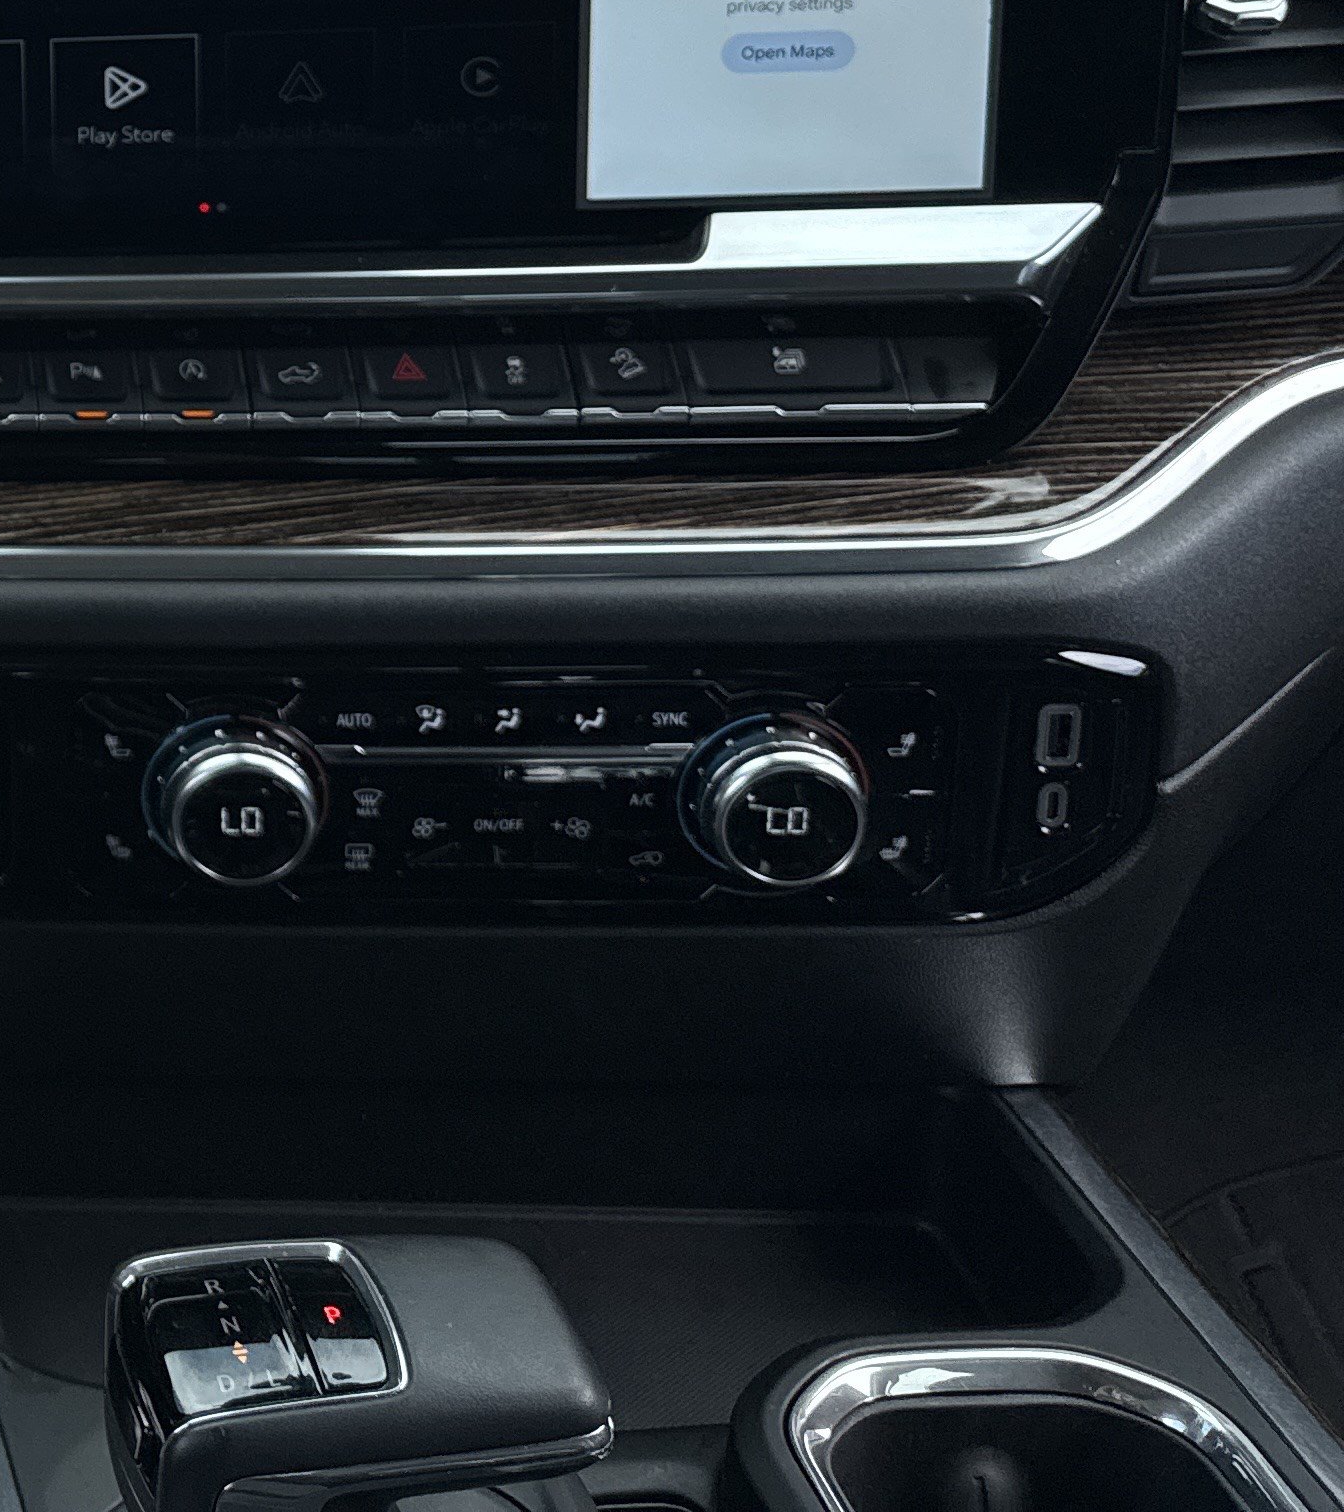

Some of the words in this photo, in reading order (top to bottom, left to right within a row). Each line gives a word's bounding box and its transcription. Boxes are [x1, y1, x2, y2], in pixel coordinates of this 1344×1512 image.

[741, 44, 786, 63] Open
[789, 42, 835, 63] Maps
[77, 125, 117, 148] Play
[121, 123, 173, 144] Store
[336, 712, 373, 729] AUTO
[652, 710, 689, 728] SYNC
[629, 792, 654, 808] A/C
[473, 817, 524, 833] ON/OFF
[204, 1278, 224, 1296] R
[324, 1304, 342, 1325] P
[220, 1316, 240, 1335] N
